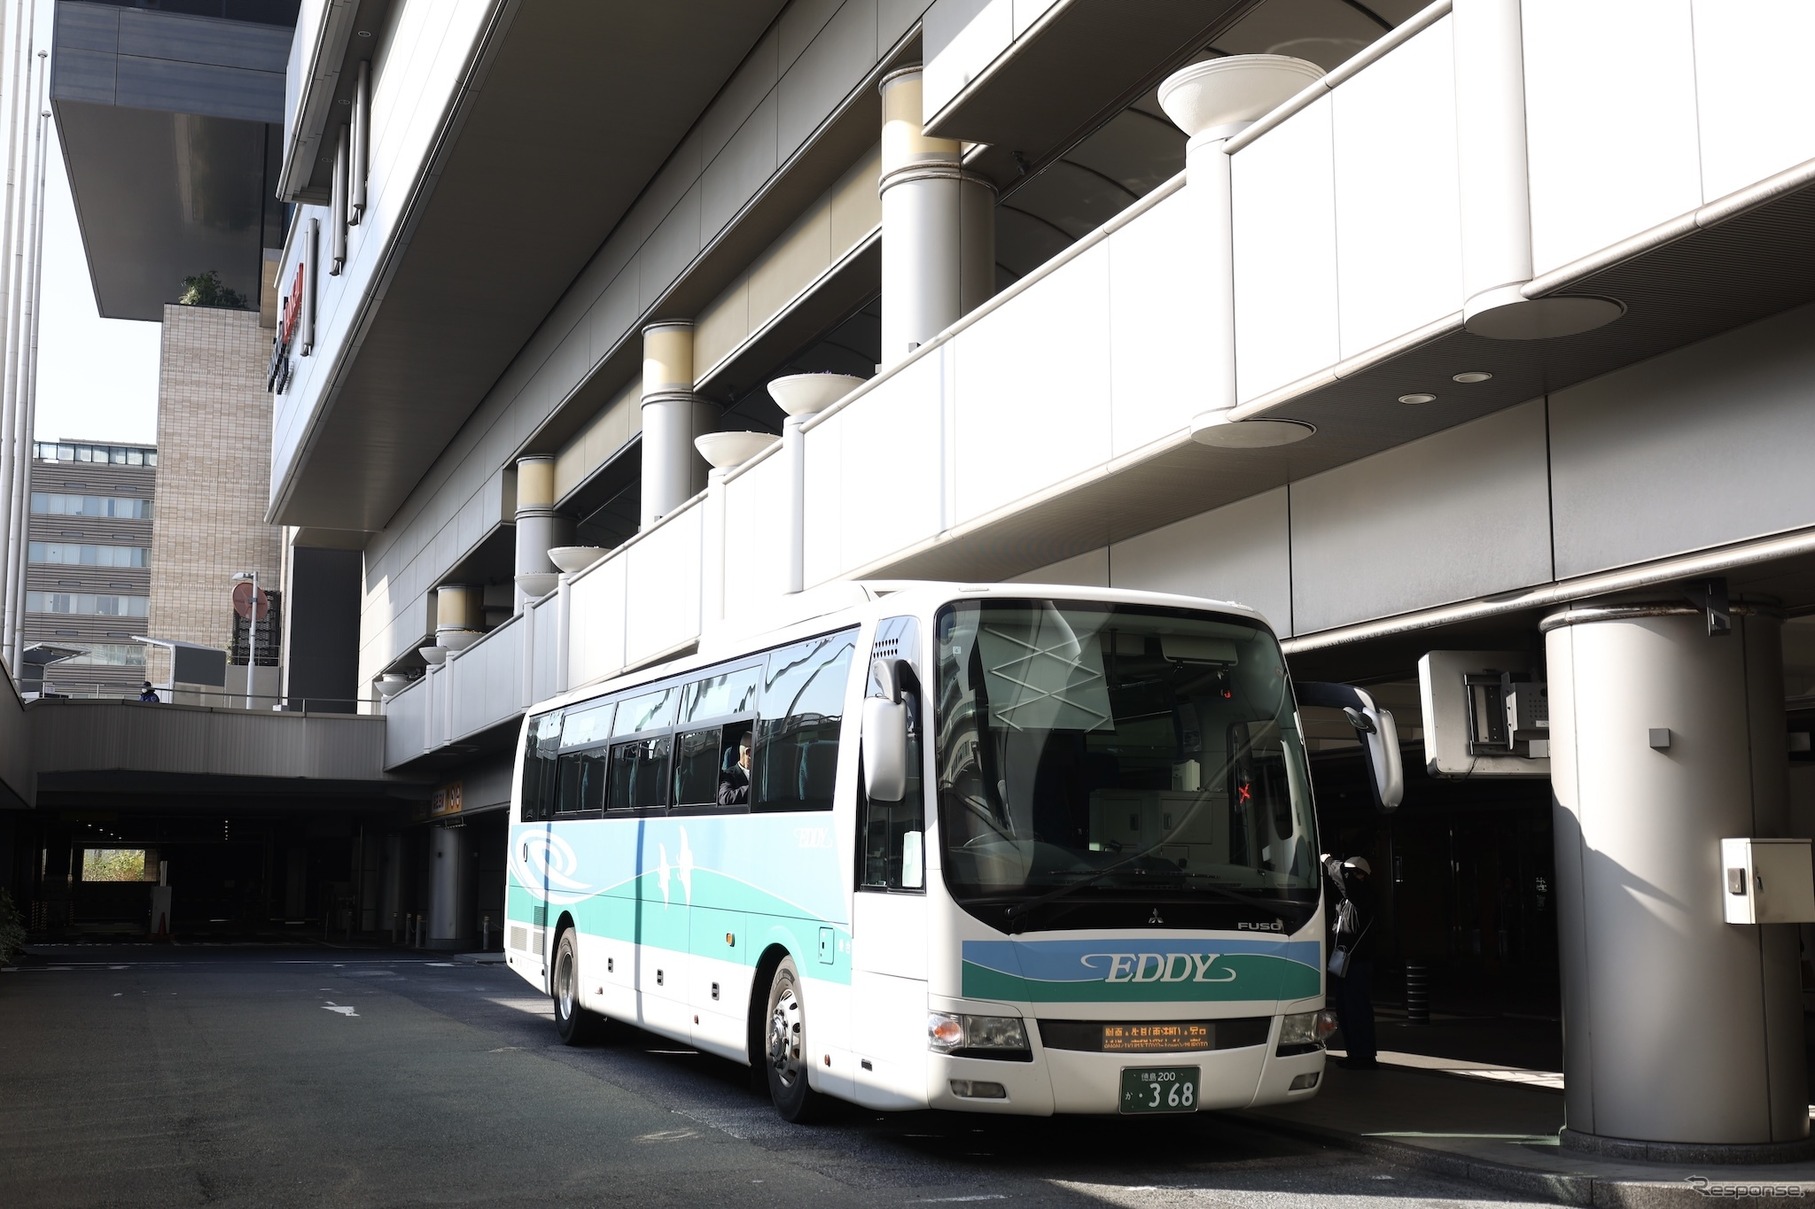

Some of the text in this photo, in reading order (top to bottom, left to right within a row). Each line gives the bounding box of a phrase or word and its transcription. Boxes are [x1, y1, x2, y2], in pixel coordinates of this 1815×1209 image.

[1237, 922, 1282, 931] FUSO
[1080, 953, 1237, 983] EDDY
[1157, 1072, 1176, 1081] 200
